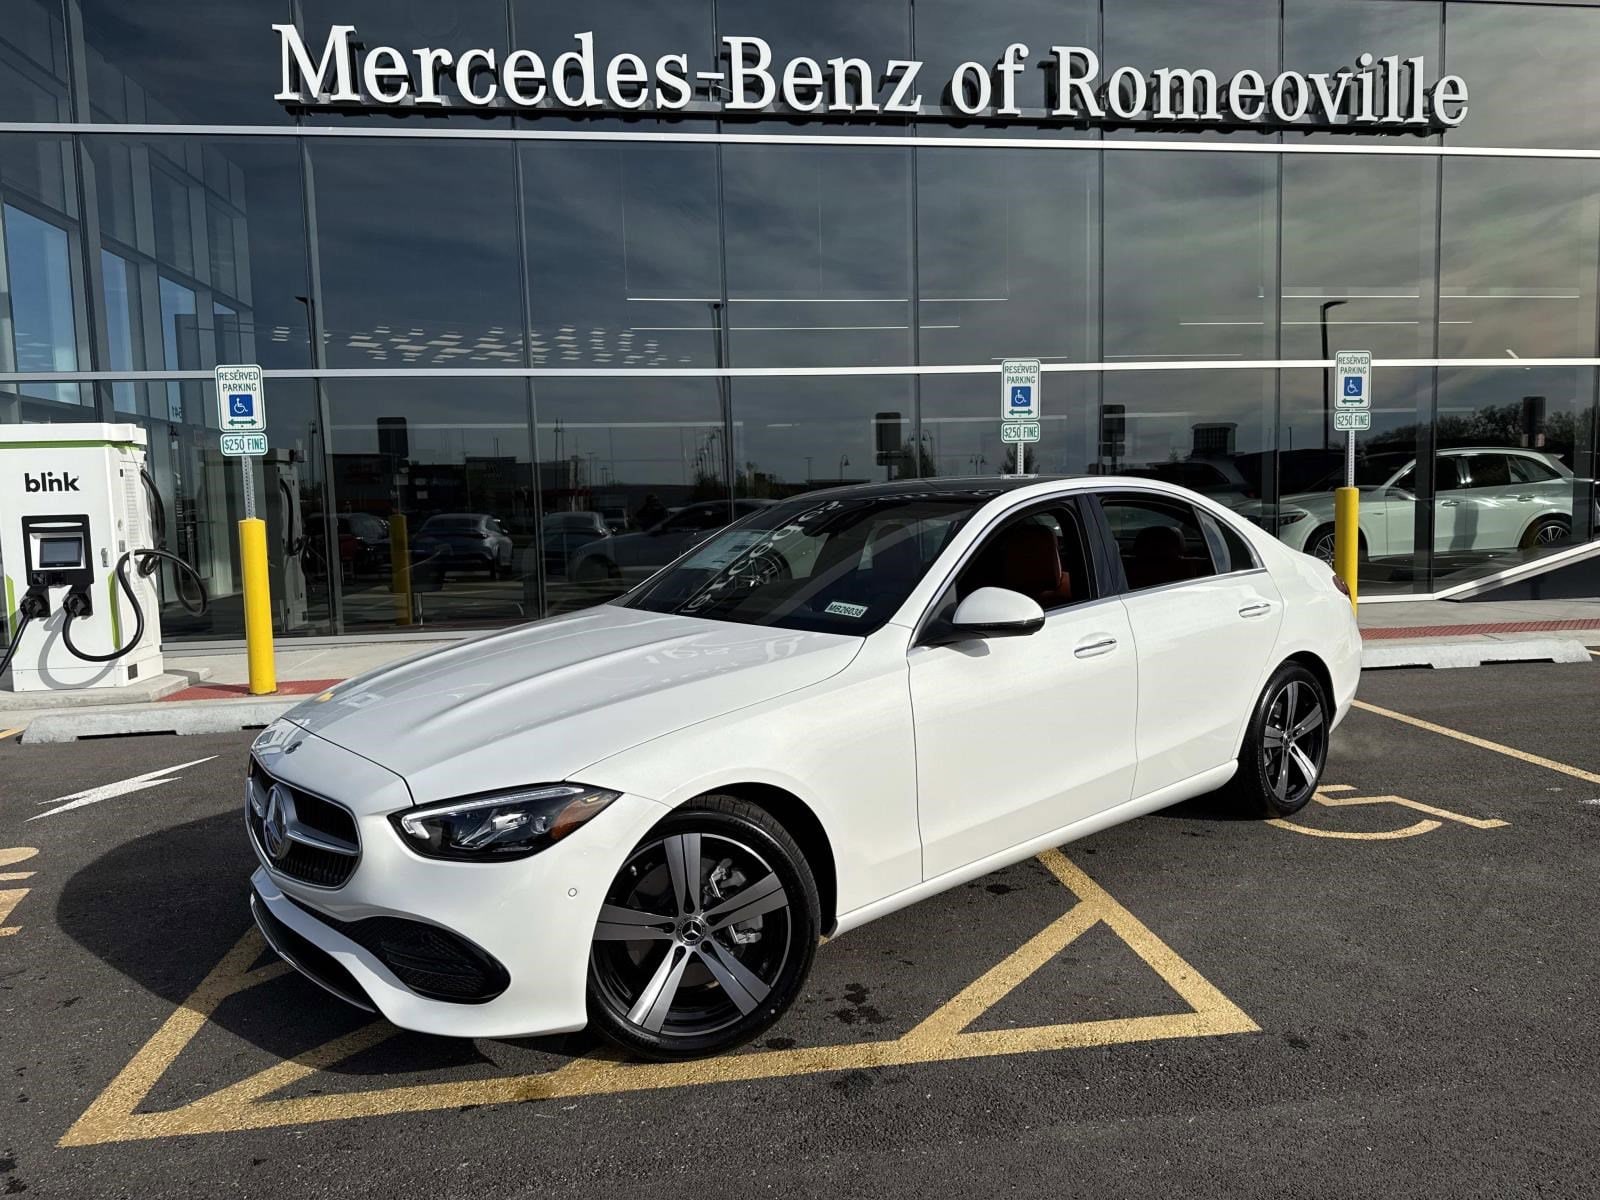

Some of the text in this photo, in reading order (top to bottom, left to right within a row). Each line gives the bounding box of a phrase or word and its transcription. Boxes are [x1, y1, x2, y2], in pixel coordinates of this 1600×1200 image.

[272, 24, 1470, 127] Mercedes-Benz of Romeoville
[1339, 357, 1369, 365] RESERVED
[1005, 366, 1037, 374] RESERVED
[1340, 366, 1367, 375] PARKING
[219, 371, 259, 381] RESERVED
[1007, 376, 1035, 384] PARKING
[222, 382, 257, 392] PARKING
[1337, 414, 1368, 426] $250 FINE
[1004, 427, 1038, 438] $250 FINE
[224, 437, 265, 451] $250 FINE
[24, 471, 80, 493] blink
